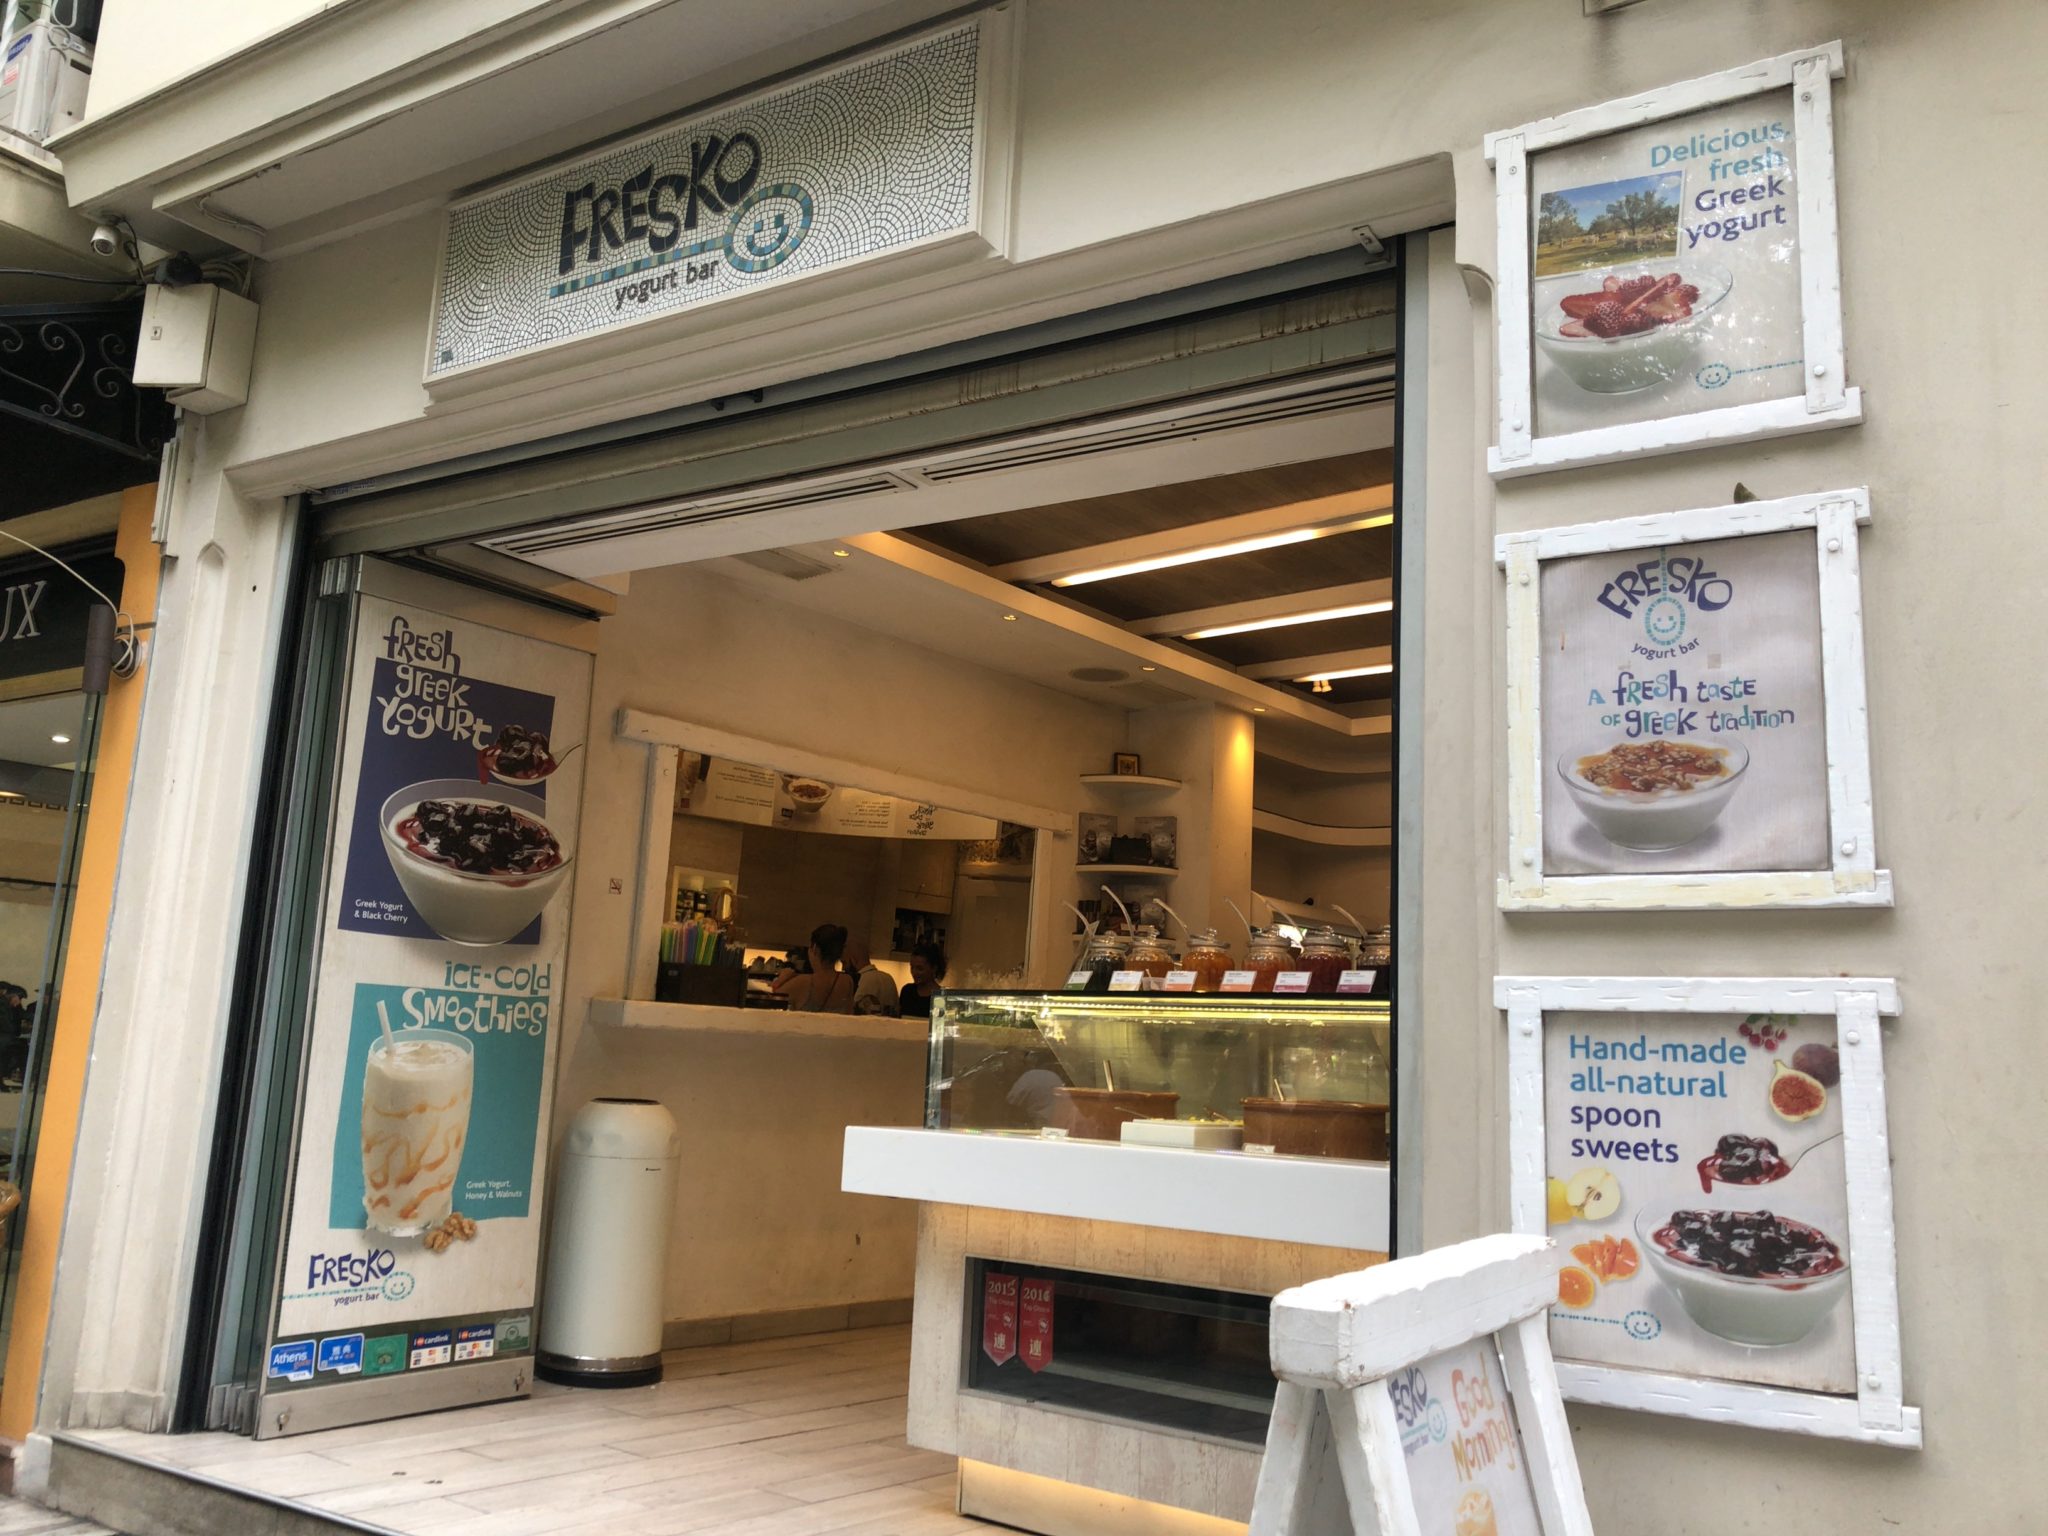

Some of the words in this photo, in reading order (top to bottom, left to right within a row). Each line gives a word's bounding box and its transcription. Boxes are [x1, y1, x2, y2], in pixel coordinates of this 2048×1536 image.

[1709, 146, 1784, 181] fresh
[559, 132, 762, 275] FRESKO
[1695, 175, 1786, 212] Greek
[1685, 204, 1787, 249] yogurt
[614, 269, 678, 311] yogurt
[686, 259, 719, 285] bar
[1597, 557, 1733, 620] FRESKO
[1631, 642, 1677, 661] yogurt
[1678, 637, 1701, 655] bar
[1588, 688, 1606, 706] A
[354, 909, 360, 919] &
[362, 911, 382, 920] Black
[383, 913, 409, 925] Cherry
[355, 898, 377, 909] Greek
[380, 901, 404, 913] Yogurt
[1570, 1034, 1747, 1065] Hand-made
[1570, 1066, 1728, 1098] all-natural
[1570, 1105, 1661, 1132] spoon
[1571, 1138, 1679, 1163] sweets
[465, 1191, 488, 1200] Honey
[496, 1190, 523, 1198] Walnuts
[466, 1180, 487, 1189] Greek
[307, 1248, 395, 1290] FRESKO
[334, 1294, 363, 1307] yogurt
[365, 1292, 380, 1302] bar
[424, 1333, 449, 1345] cardlink
[468, 1327, 492, 1338] cardlink
[273, 1351, 308, 1365] Athens
[1388, 1367, 1427, 1427] ESKO
